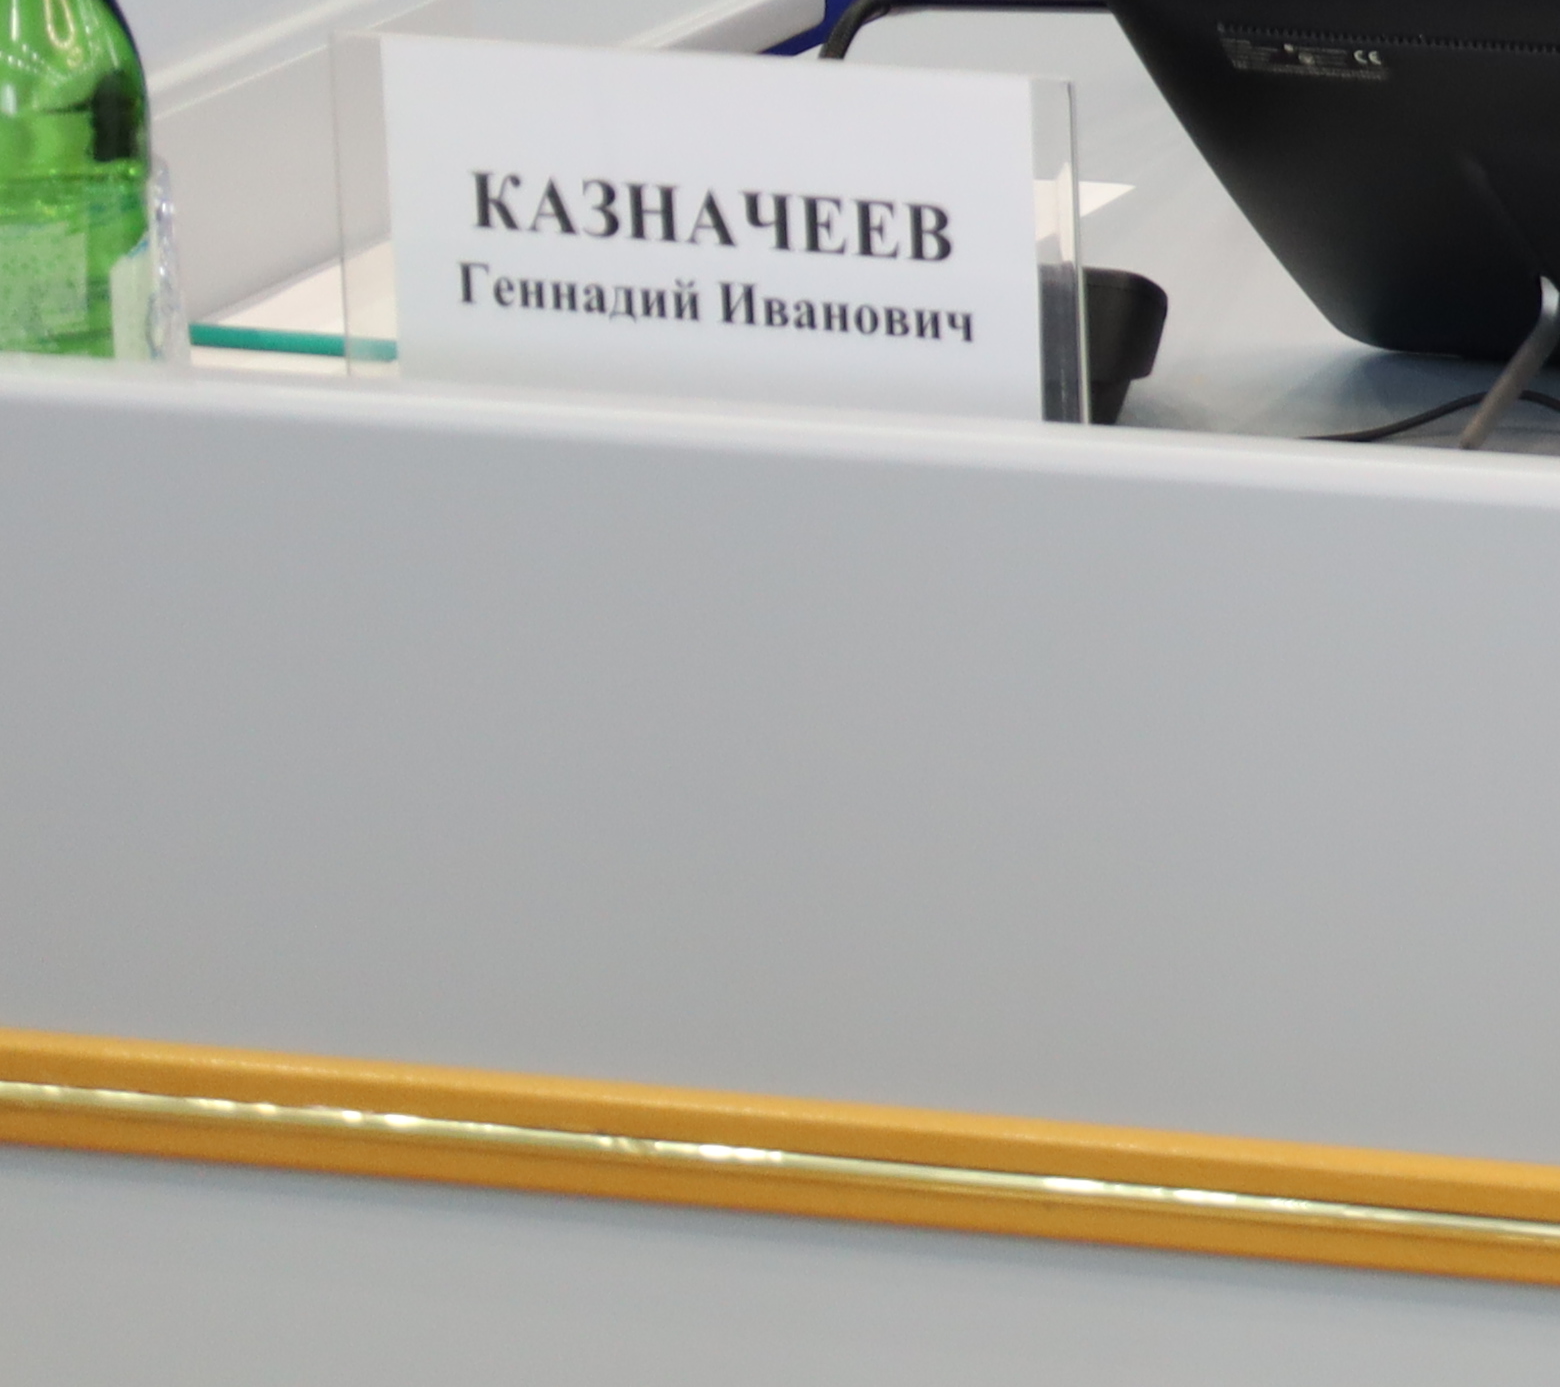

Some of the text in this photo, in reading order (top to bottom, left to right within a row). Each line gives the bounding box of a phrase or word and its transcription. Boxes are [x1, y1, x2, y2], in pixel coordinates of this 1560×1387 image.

[469, 170, 955, 264] КАЗНАЧЕЕВ
[457, 261, 976, 345] Геннадий Иванович
